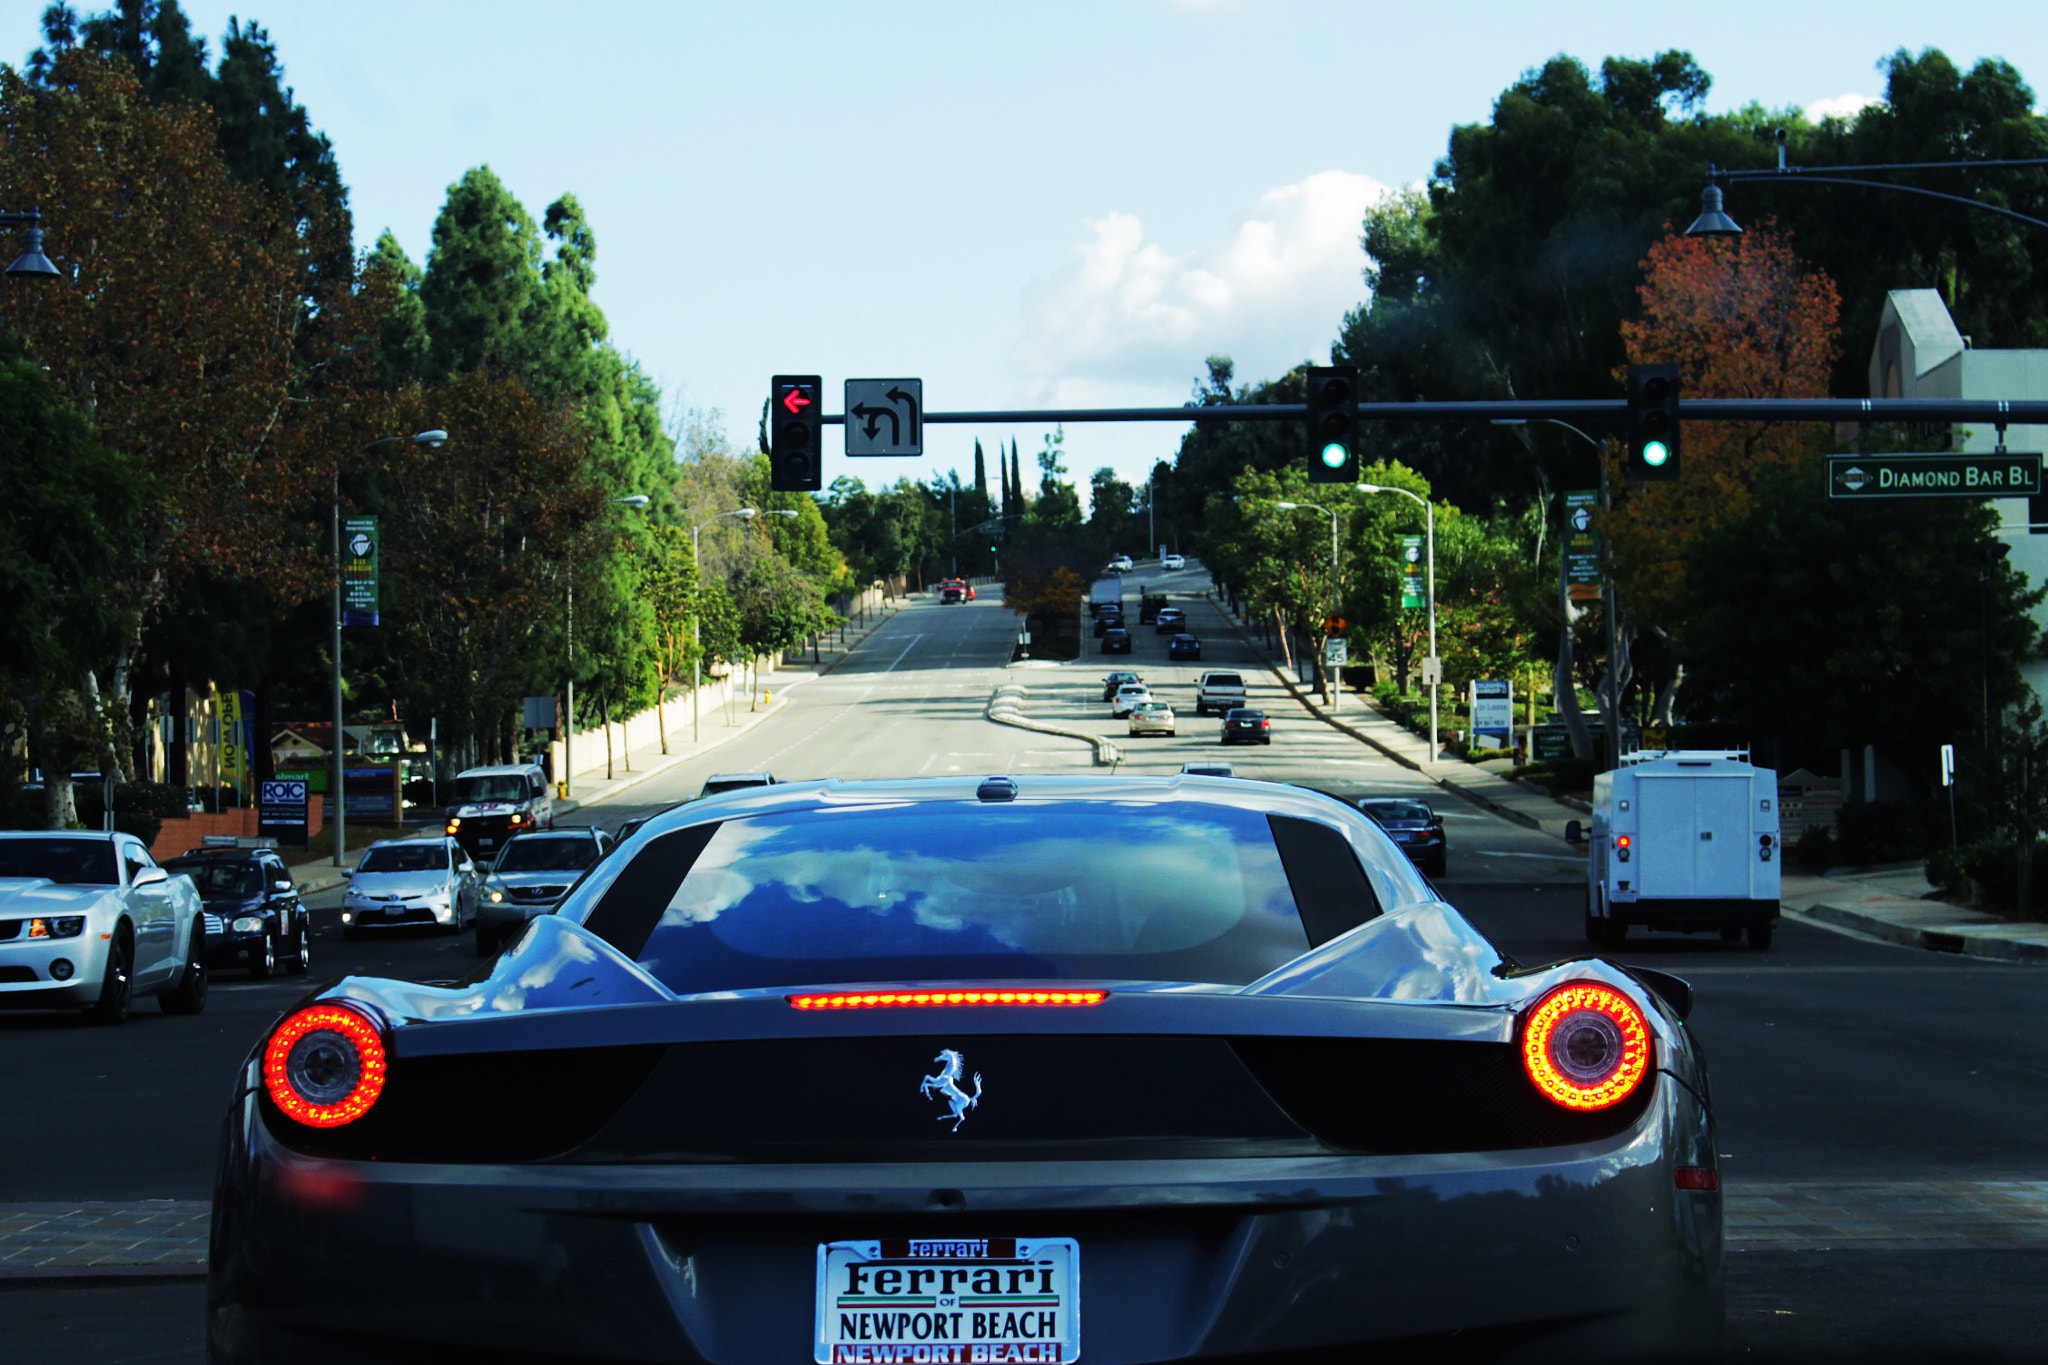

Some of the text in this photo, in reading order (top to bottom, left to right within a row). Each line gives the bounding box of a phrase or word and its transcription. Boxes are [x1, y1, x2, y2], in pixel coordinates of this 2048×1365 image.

[1328, 653, 1344, 662] 45
[264, 783, 304, 798] ROIC
[908, 1239, 988, 1257] Ferrari
[843, 1259, 1054, 1294] Ferrari
[939, 1298, 956, 1307] OF
[840, 1311, 1056, 1340] NEWPORT BEACH
[837, 1344, 1057, 1364] NEWPORT BEACH
